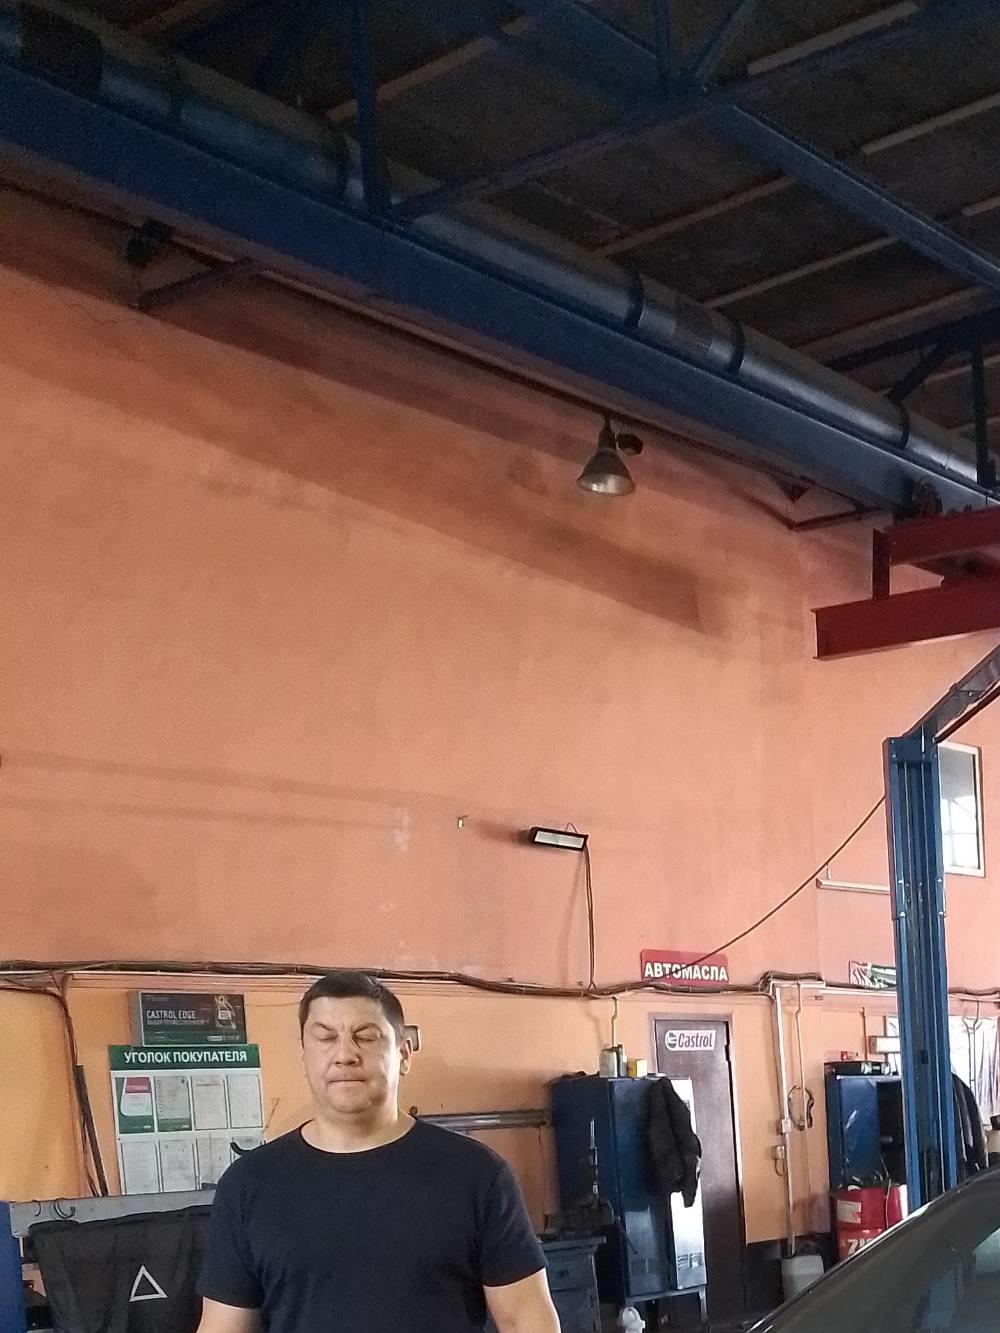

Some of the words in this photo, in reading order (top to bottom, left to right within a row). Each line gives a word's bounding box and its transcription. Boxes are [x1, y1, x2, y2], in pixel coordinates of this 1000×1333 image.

[644, 961, 729, 982] АВТОМАСЛА
[146, 1009, 177, 1020] CASTROL
[178, 1010, 197, 1020] EDGE
[678, 1032, 714, 1049] Castrol
[123, 1051, 172, 1064] УГОЛОК
[172, 1050, 249, 1063] ПОКУПАТЕЛЯ
